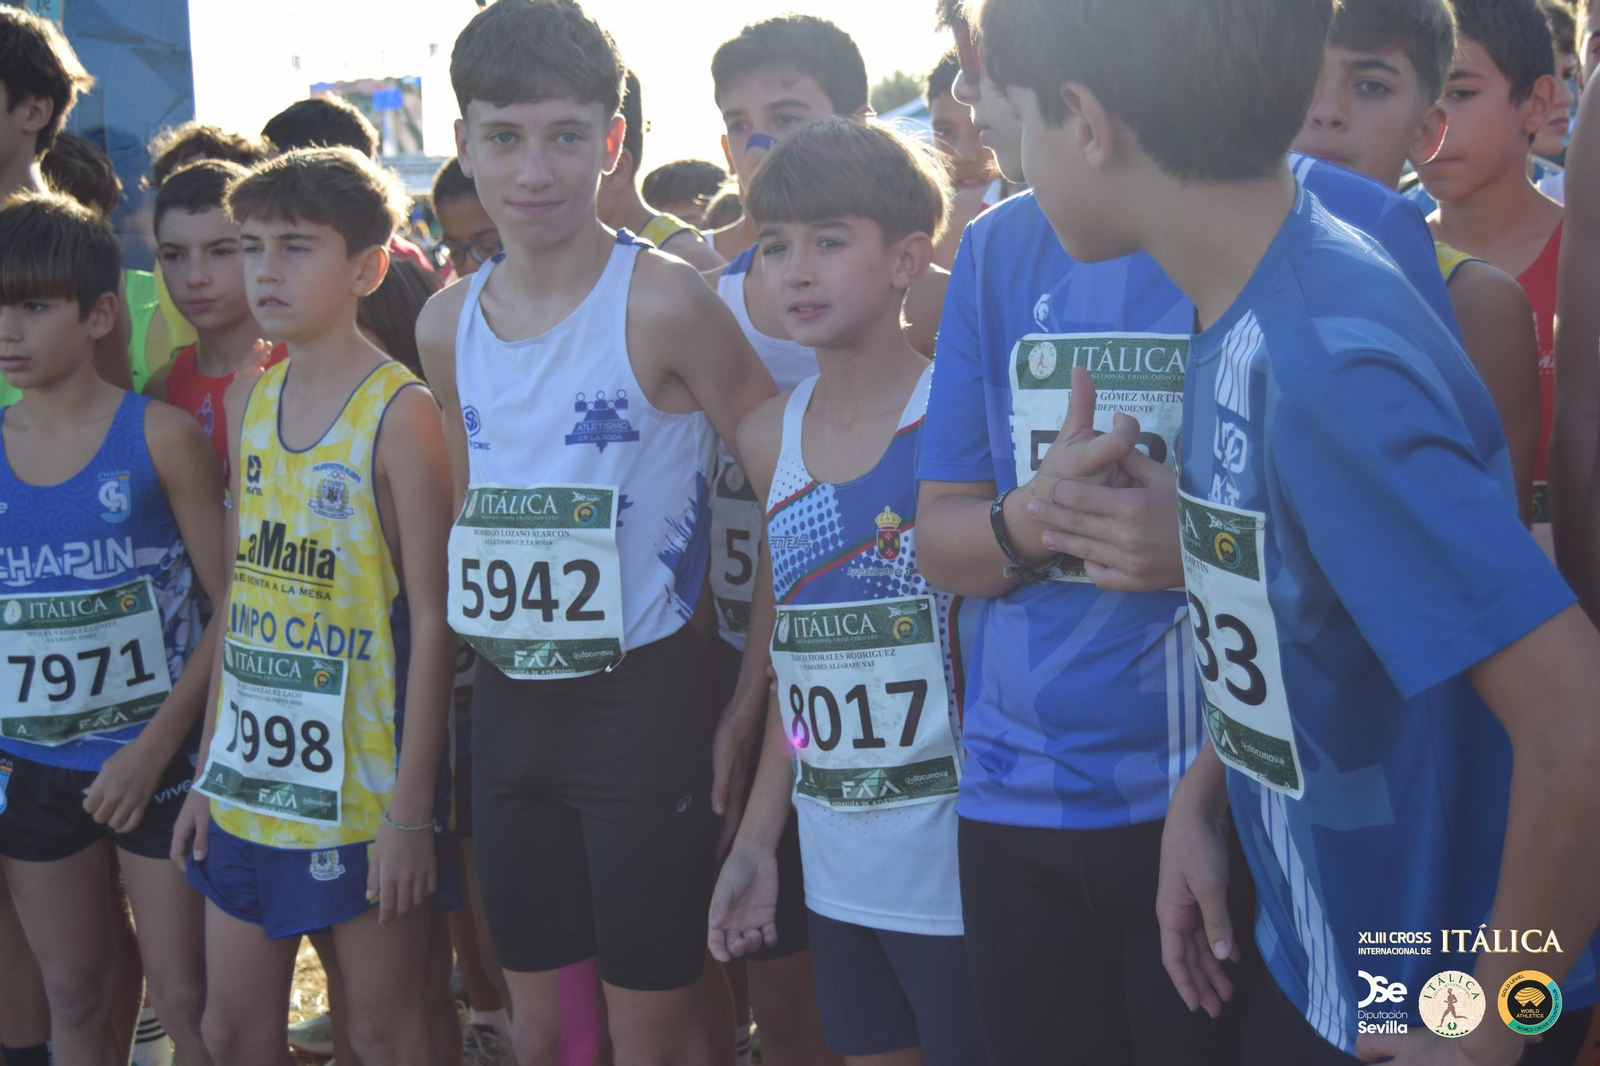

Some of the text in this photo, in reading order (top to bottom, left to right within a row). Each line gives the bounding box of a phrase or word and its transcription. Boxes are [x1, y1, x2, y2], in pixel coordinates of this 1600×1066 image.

[1072, 340, 1185, 373] ITÁLICA
[1100, 390, 1138, 401] GÓMEZ
[1140, 391, 1183, 403] MARTÍN
[577, 421, 628, 431] ATLETISMO
[481, 490, 559, 515] ITÁLICA
[501, 529, 530, 537] LOZANO
[531, 530, 570, 538] ALARCON
[847, 567, 893, 577] Ayuntamiento
[281, 583, 295, 595] LA
[299, 587, 332, 601] MESA
[462, 558, 605, 622] 5942
[30, 597, 107, 620] ITÁLICA
[55, 625, 88, 636] VÁZQUEZ
[228, 603, 373, 662] IMPO CÁDIZ
[794, 611, 877, 638] ITÁLICA
[235, 651, 302, 678] ITÁLICA
[808, 652, 844, 662] MORALES
[846, 648, 897, 660] RODRIGUEZ
[8, 639, 155, 703] 7971
[829, 662, 861, 670] ALJARAFE
[790, 679, 928, 751] 8017
[912, 770, 948, 783] docunova
